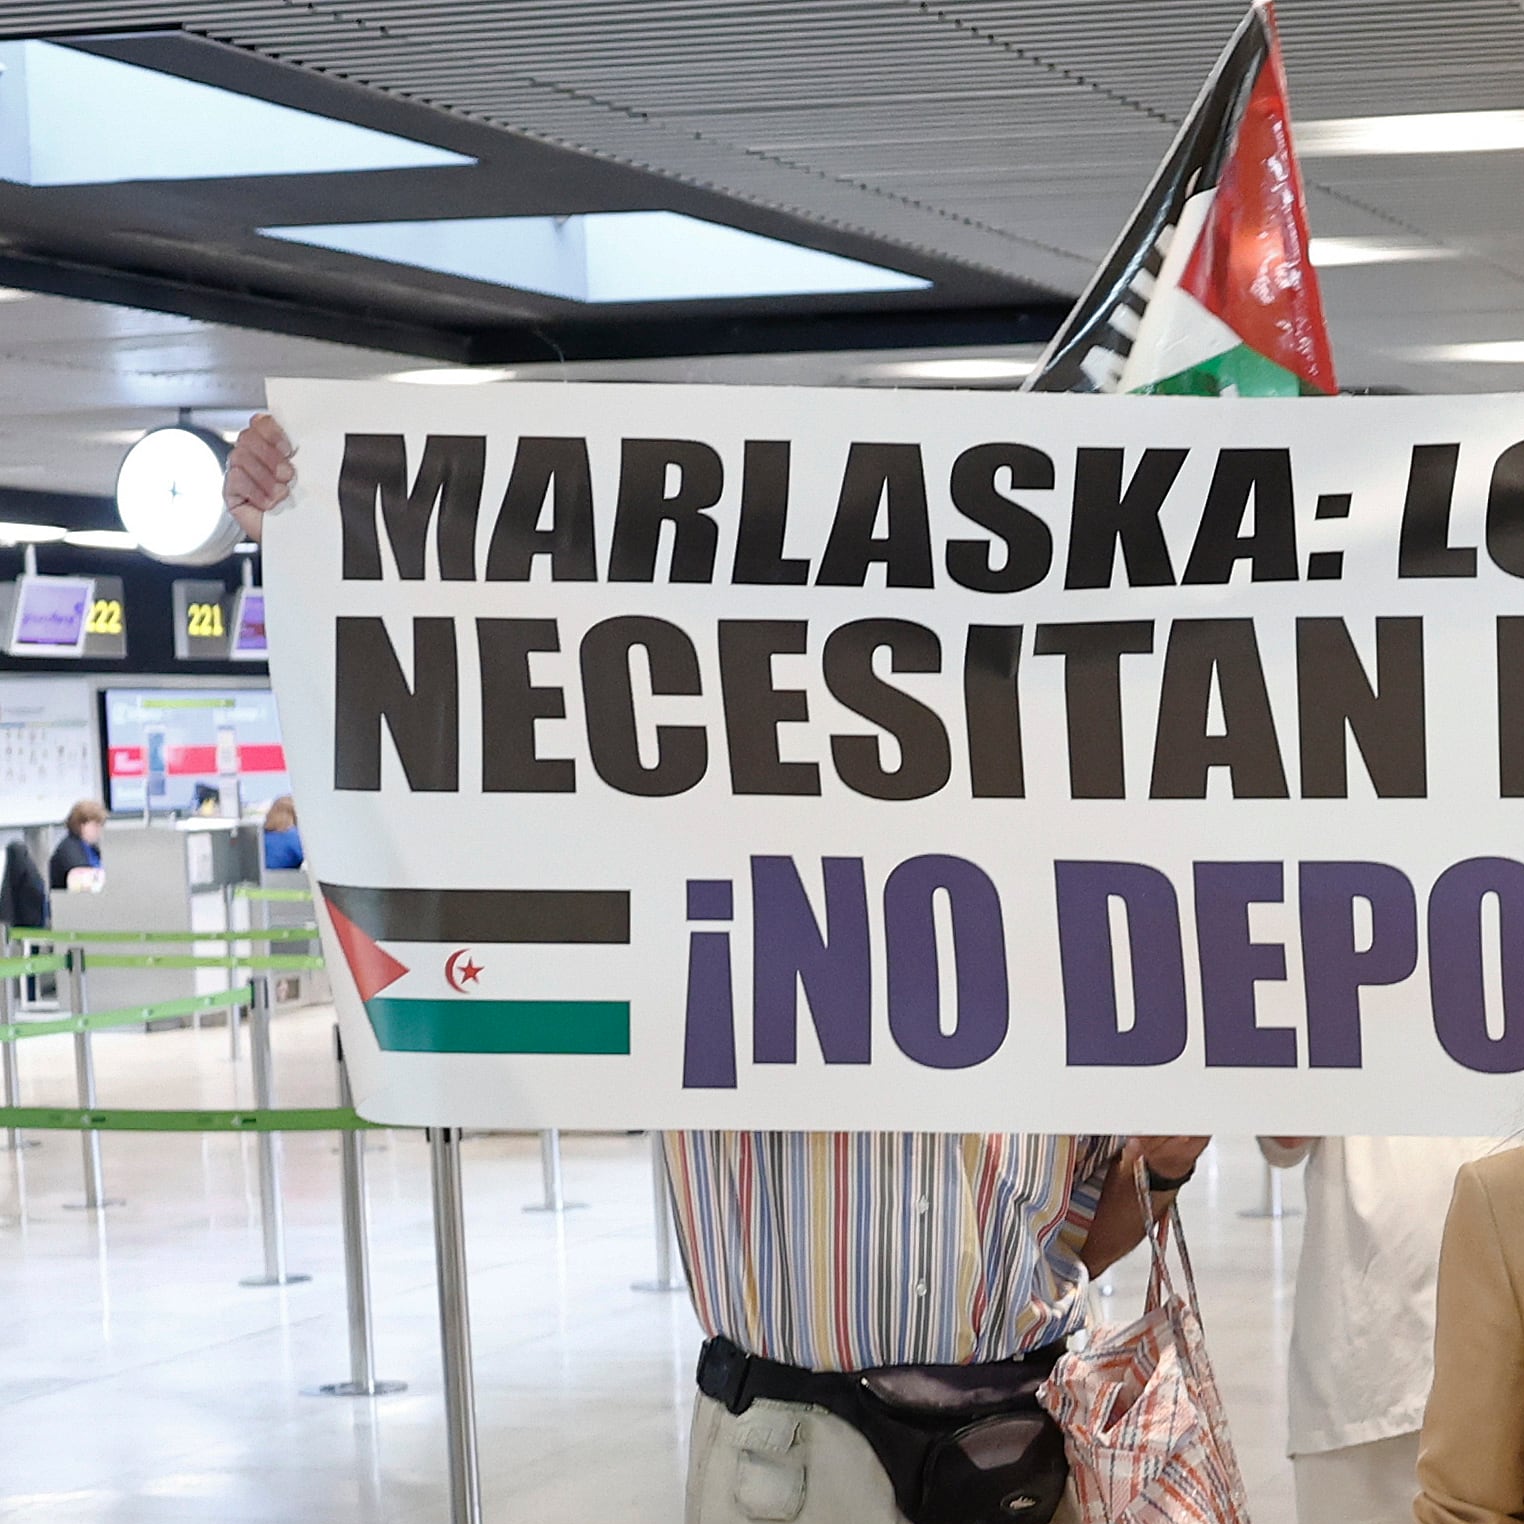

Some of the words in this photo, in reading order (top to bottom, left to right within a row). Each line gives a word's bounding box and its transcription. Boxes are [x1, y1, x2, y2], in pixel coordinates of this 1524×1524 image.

[338, 432, 1353, 595] MARLASKA:
[188, 602, 224, 637] 221
[333, 614, 1428, 802] NECESITAN
[682, 853, 1010, 1089] ¡NO
